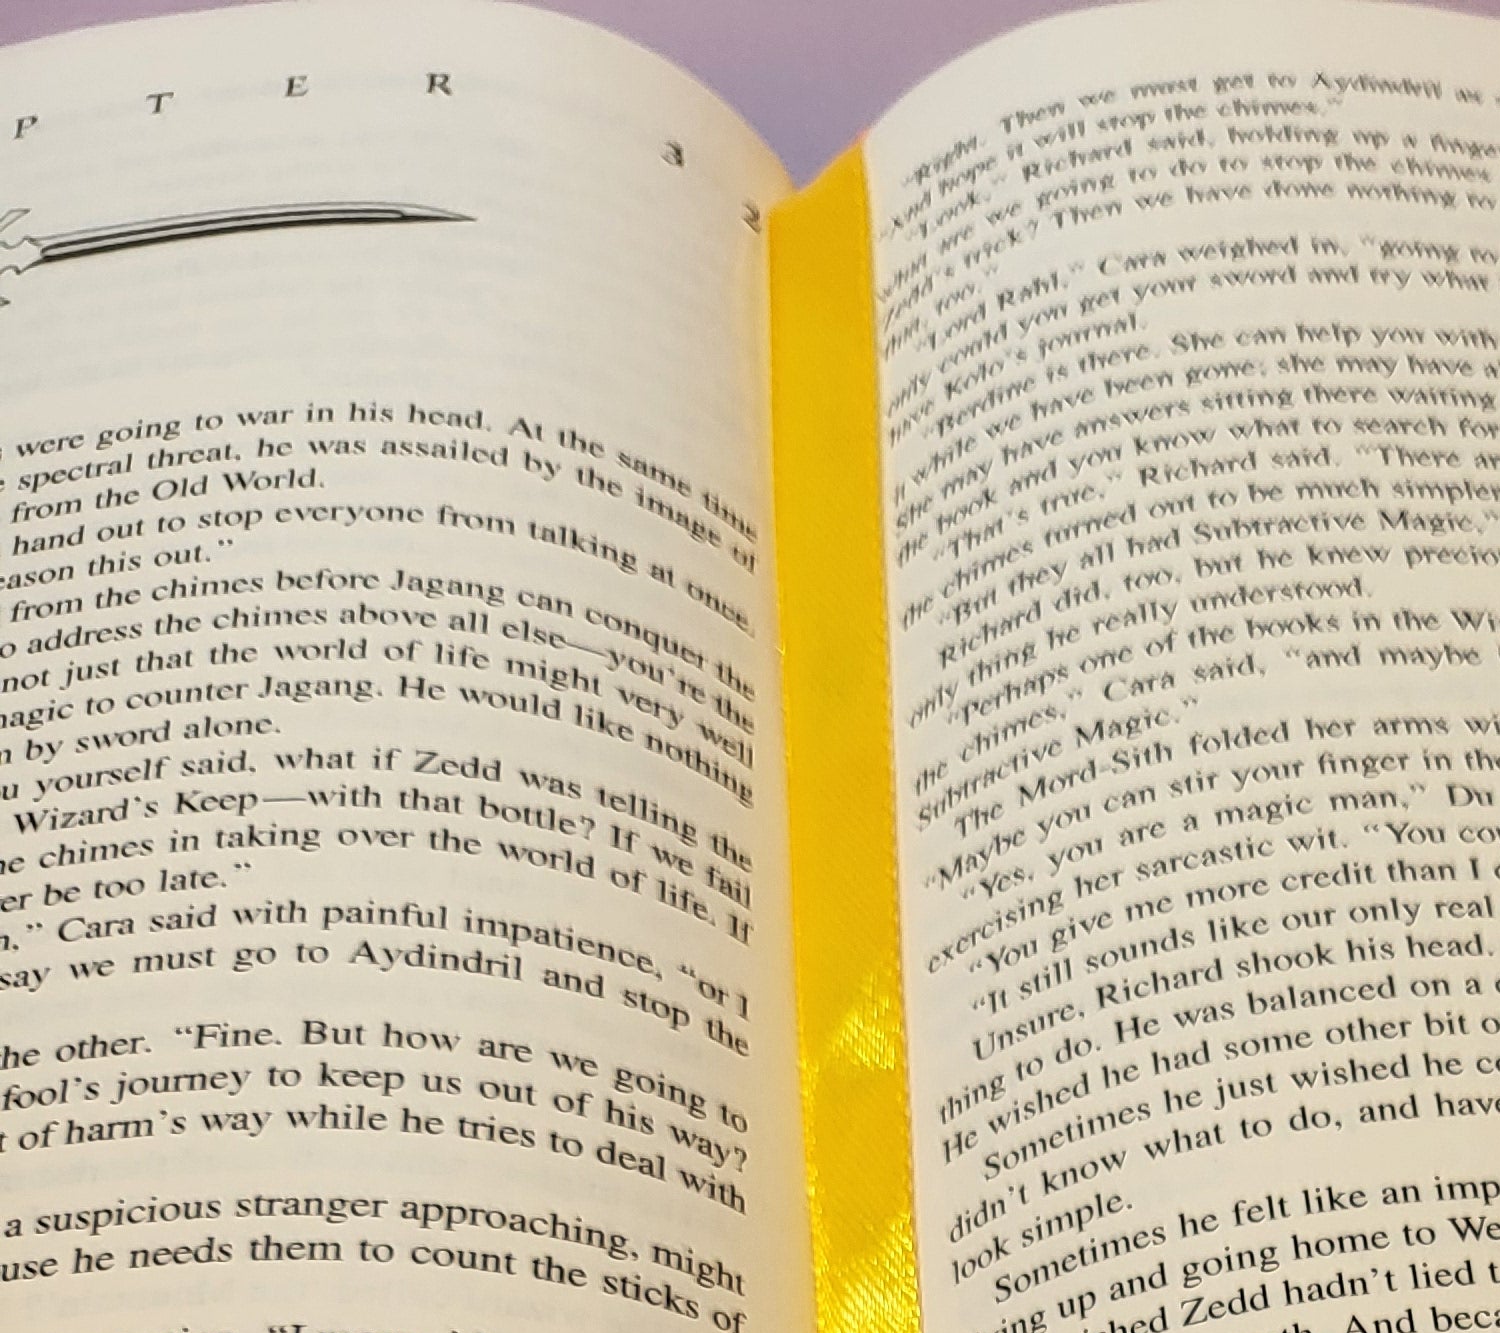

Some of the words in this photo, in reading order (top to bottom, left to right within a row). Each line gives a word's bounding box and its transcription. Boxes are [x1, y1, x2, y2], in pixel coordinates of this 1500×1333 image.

[15, 433, 85, 458] were
[95, 418, 182, 451] going
[195, 413, 224, 432] to
[235, 408, 295, 427] war
[305, 401, 334, 424] in
[348, 401, 394, 423] his
[407, 402, 492, 433] head.
[953, 801, 1004, 840] The
[1015, 739, 1173, 809] Mord-Sith
[1188, 718, 1291, 757] folded
[1303, 715, 1357, 741] her
[1372, 715, 1451, 736] arms
[67, 959, 116, 981] we
[131, 946, 217, 974] must
[231, 946, 278, 973] go
[295, 942, 330, 964] to
[347, 939, 523, 982] Aydindril
[541, 967, 605, 999] and
[619, 987, 691, 1032] stop
[703, 1016, 750, 1057] the
[3, 1218, 24, 1239] a
[33, 1195, 222, 1237] suspicious
[233, 1193, 389, 1225] stranger
[399, 1200, 639, 1262] approaching,
[649, 1243, 746, 1297] might
[993, 1225, 1167, 1305] Sometimes
[1177, 1211, 1220, 1239] he
[1231, 1193, 1292, 1228] felt
[1301, 1184, 1369, 1216] like
[1381, 1183, 1423, 1206] an
